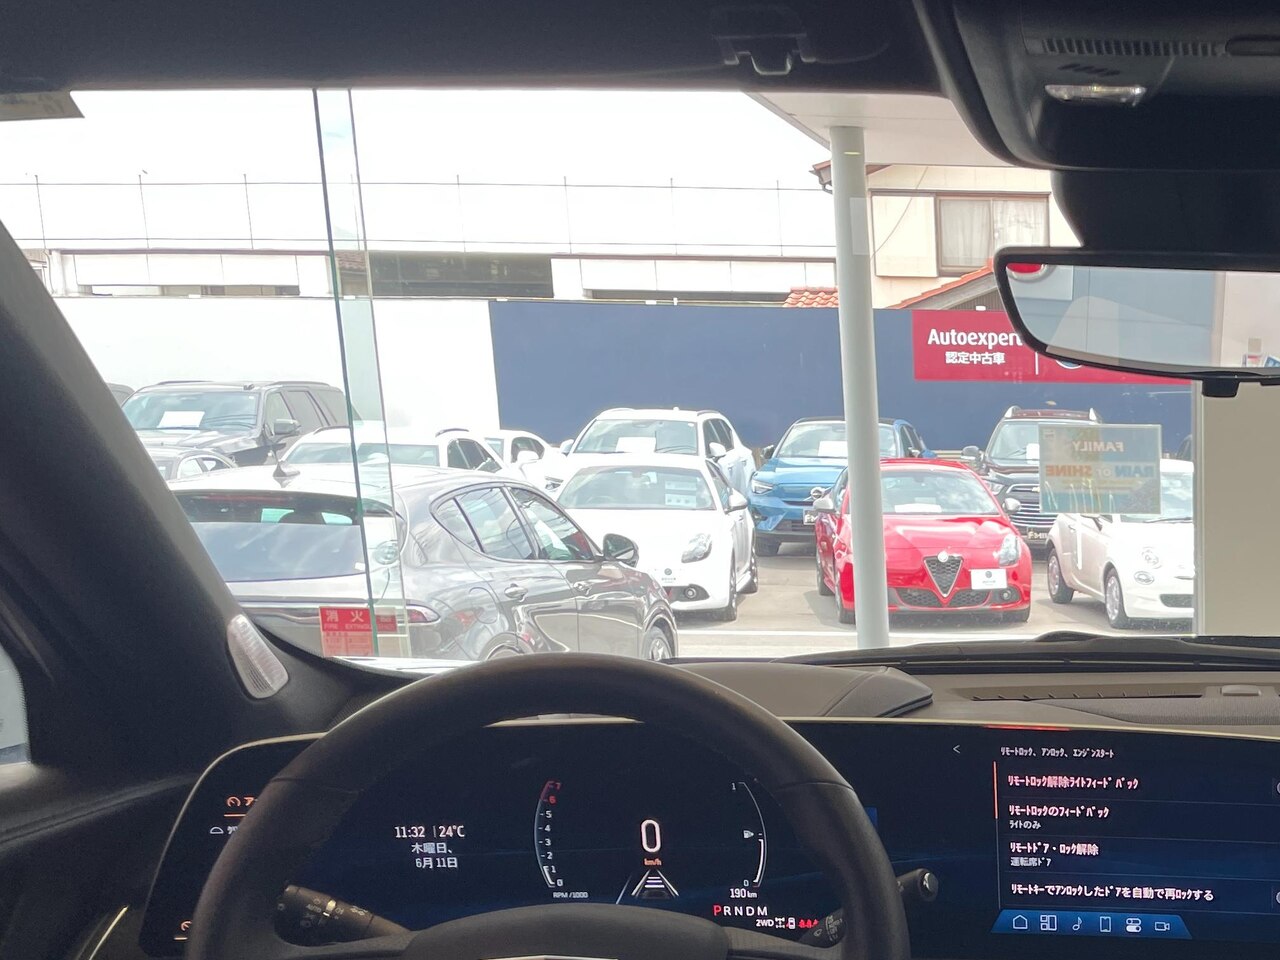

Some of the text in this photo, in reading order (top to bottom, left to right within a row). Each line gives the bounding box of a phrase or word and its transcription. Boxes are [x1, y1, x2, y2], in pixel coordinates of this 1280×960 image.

[945, 351, 1005, 365] 認定中古車
[548, 795, 556, 804] 6
[545, 810, 552, 818] 5
[394, 825, 465, 838] 11:32 24°C
[544, 824, 551, 832] 4
[640, 819, 661, 853] 0
[545, 838, 552, 846] 3
[547, 852, 553, 860] 2
[644, 858, 662, 866] km/h
[551, 865, 557, 873] 1
[556, 879, 563, 887] 0
[743, 879, 749, 887] 0
[730, 888, 758, 899] 190 km
[713, 904, 768, 916] P R N D M
[755, 918, 774, 927] 2WD
